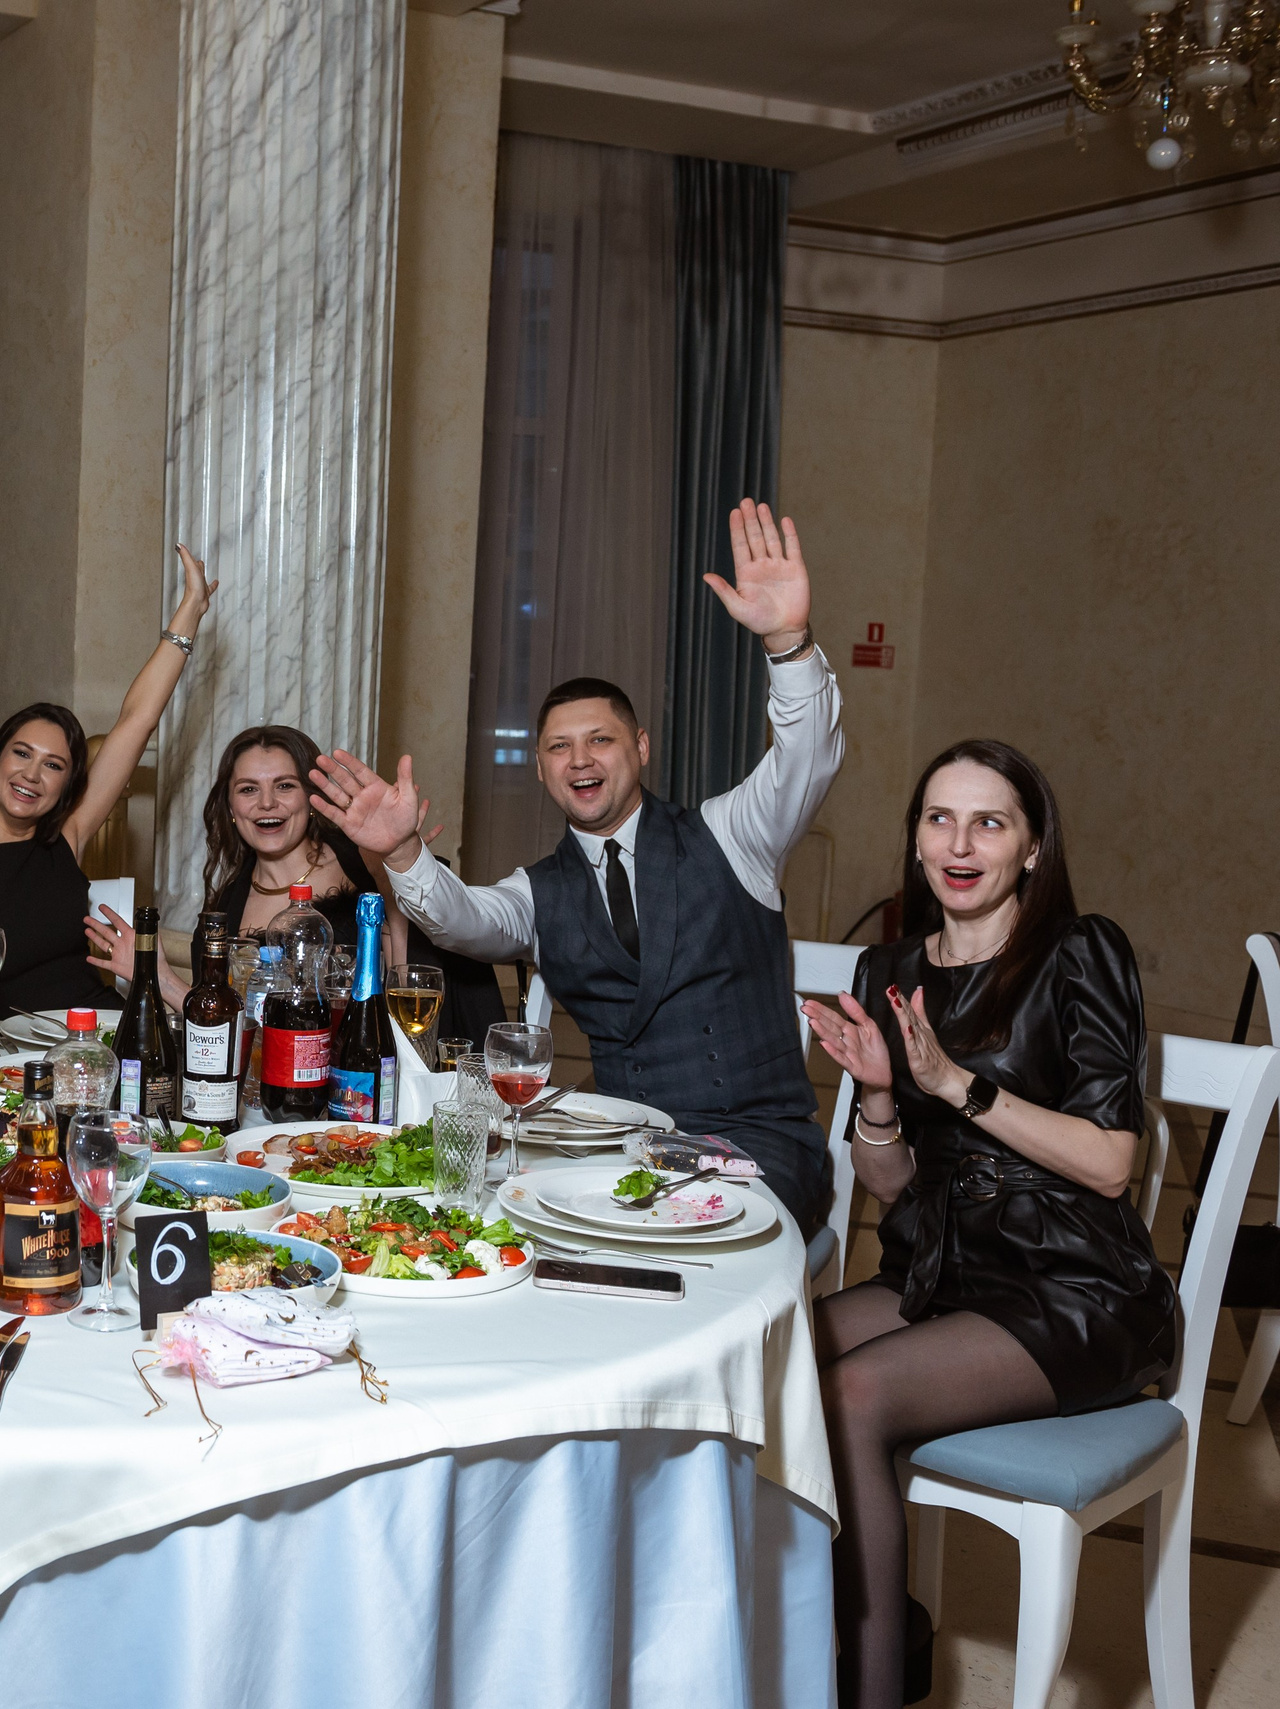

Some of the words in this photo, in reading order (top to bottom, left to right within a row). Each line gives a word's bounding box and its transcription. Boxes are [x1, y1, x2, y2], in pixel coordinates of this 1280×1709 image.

[189, 1031, 225, 1045] Dewar's
[201, 1047, 210, 1057] 12
[46, 1246, 70, 1260] 1900
[150, 1221, 197, 1285] 6
